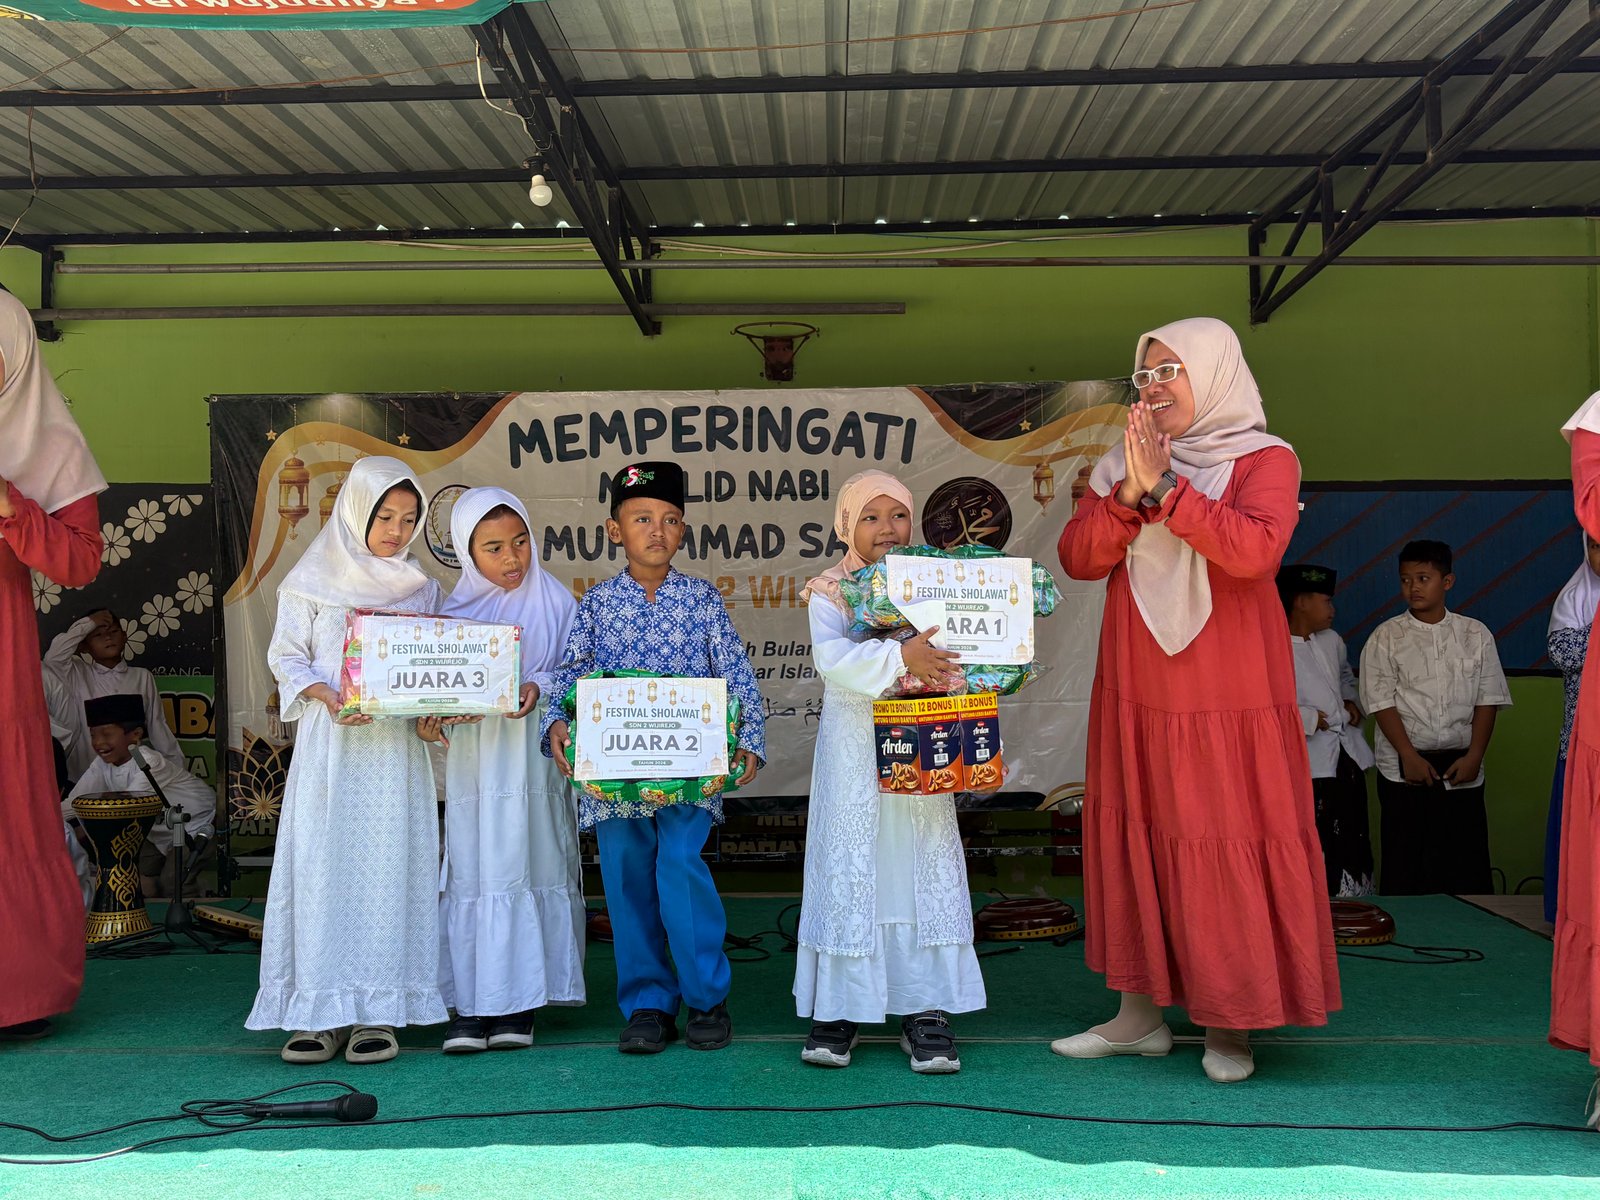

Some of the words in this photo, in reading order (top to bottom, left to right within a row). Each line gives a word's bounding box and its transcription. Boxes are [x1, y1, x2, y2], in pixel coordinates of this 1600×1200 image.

[508, 405, 917, 469] MEMPERINGATI
[599, 470, 737, 503] LID
[748, 469, 829, 501] NABI
[542, 523, 785, 561] MUMMAD
[799, 522, 848, 560] SA
[917, 586, 959, 599] FESTIVAL
[961, 588, 1008, 600] SHOLAWAT
[946, 617, 989, 635] ARA
[994, 618, 1002, 636] 1
[392, 643, 435, 655] FESTIVAL
[437, 643, 488, 654] SHOLAWAT
[391, 671, 467, 689] JUARA
[472, 670, 485, 688] 3
[873, 703, 889, 713] PROMO
[890, 703, 895, 713] 12
[895, 703, 914, 713] BONUS
[918, 702, 926, 712] 12
[927, 700, 952, 711] BONUS
[960, 699, 967, 709] 12
[969, 697, 992, 707] BONUS
[993, 696, 997, 705] 1
[605, 707, 648, 718] FESTIVAL
[651, 708, 700, 719] SHOLAWAT
[930, 730, 949, 740] Arden
[972, 726, 989, 736] Arden
[605, 734, 681, 751] JUARA
[685, 735, 698, 751] 2
[882, 738, 914, 756] Arden
